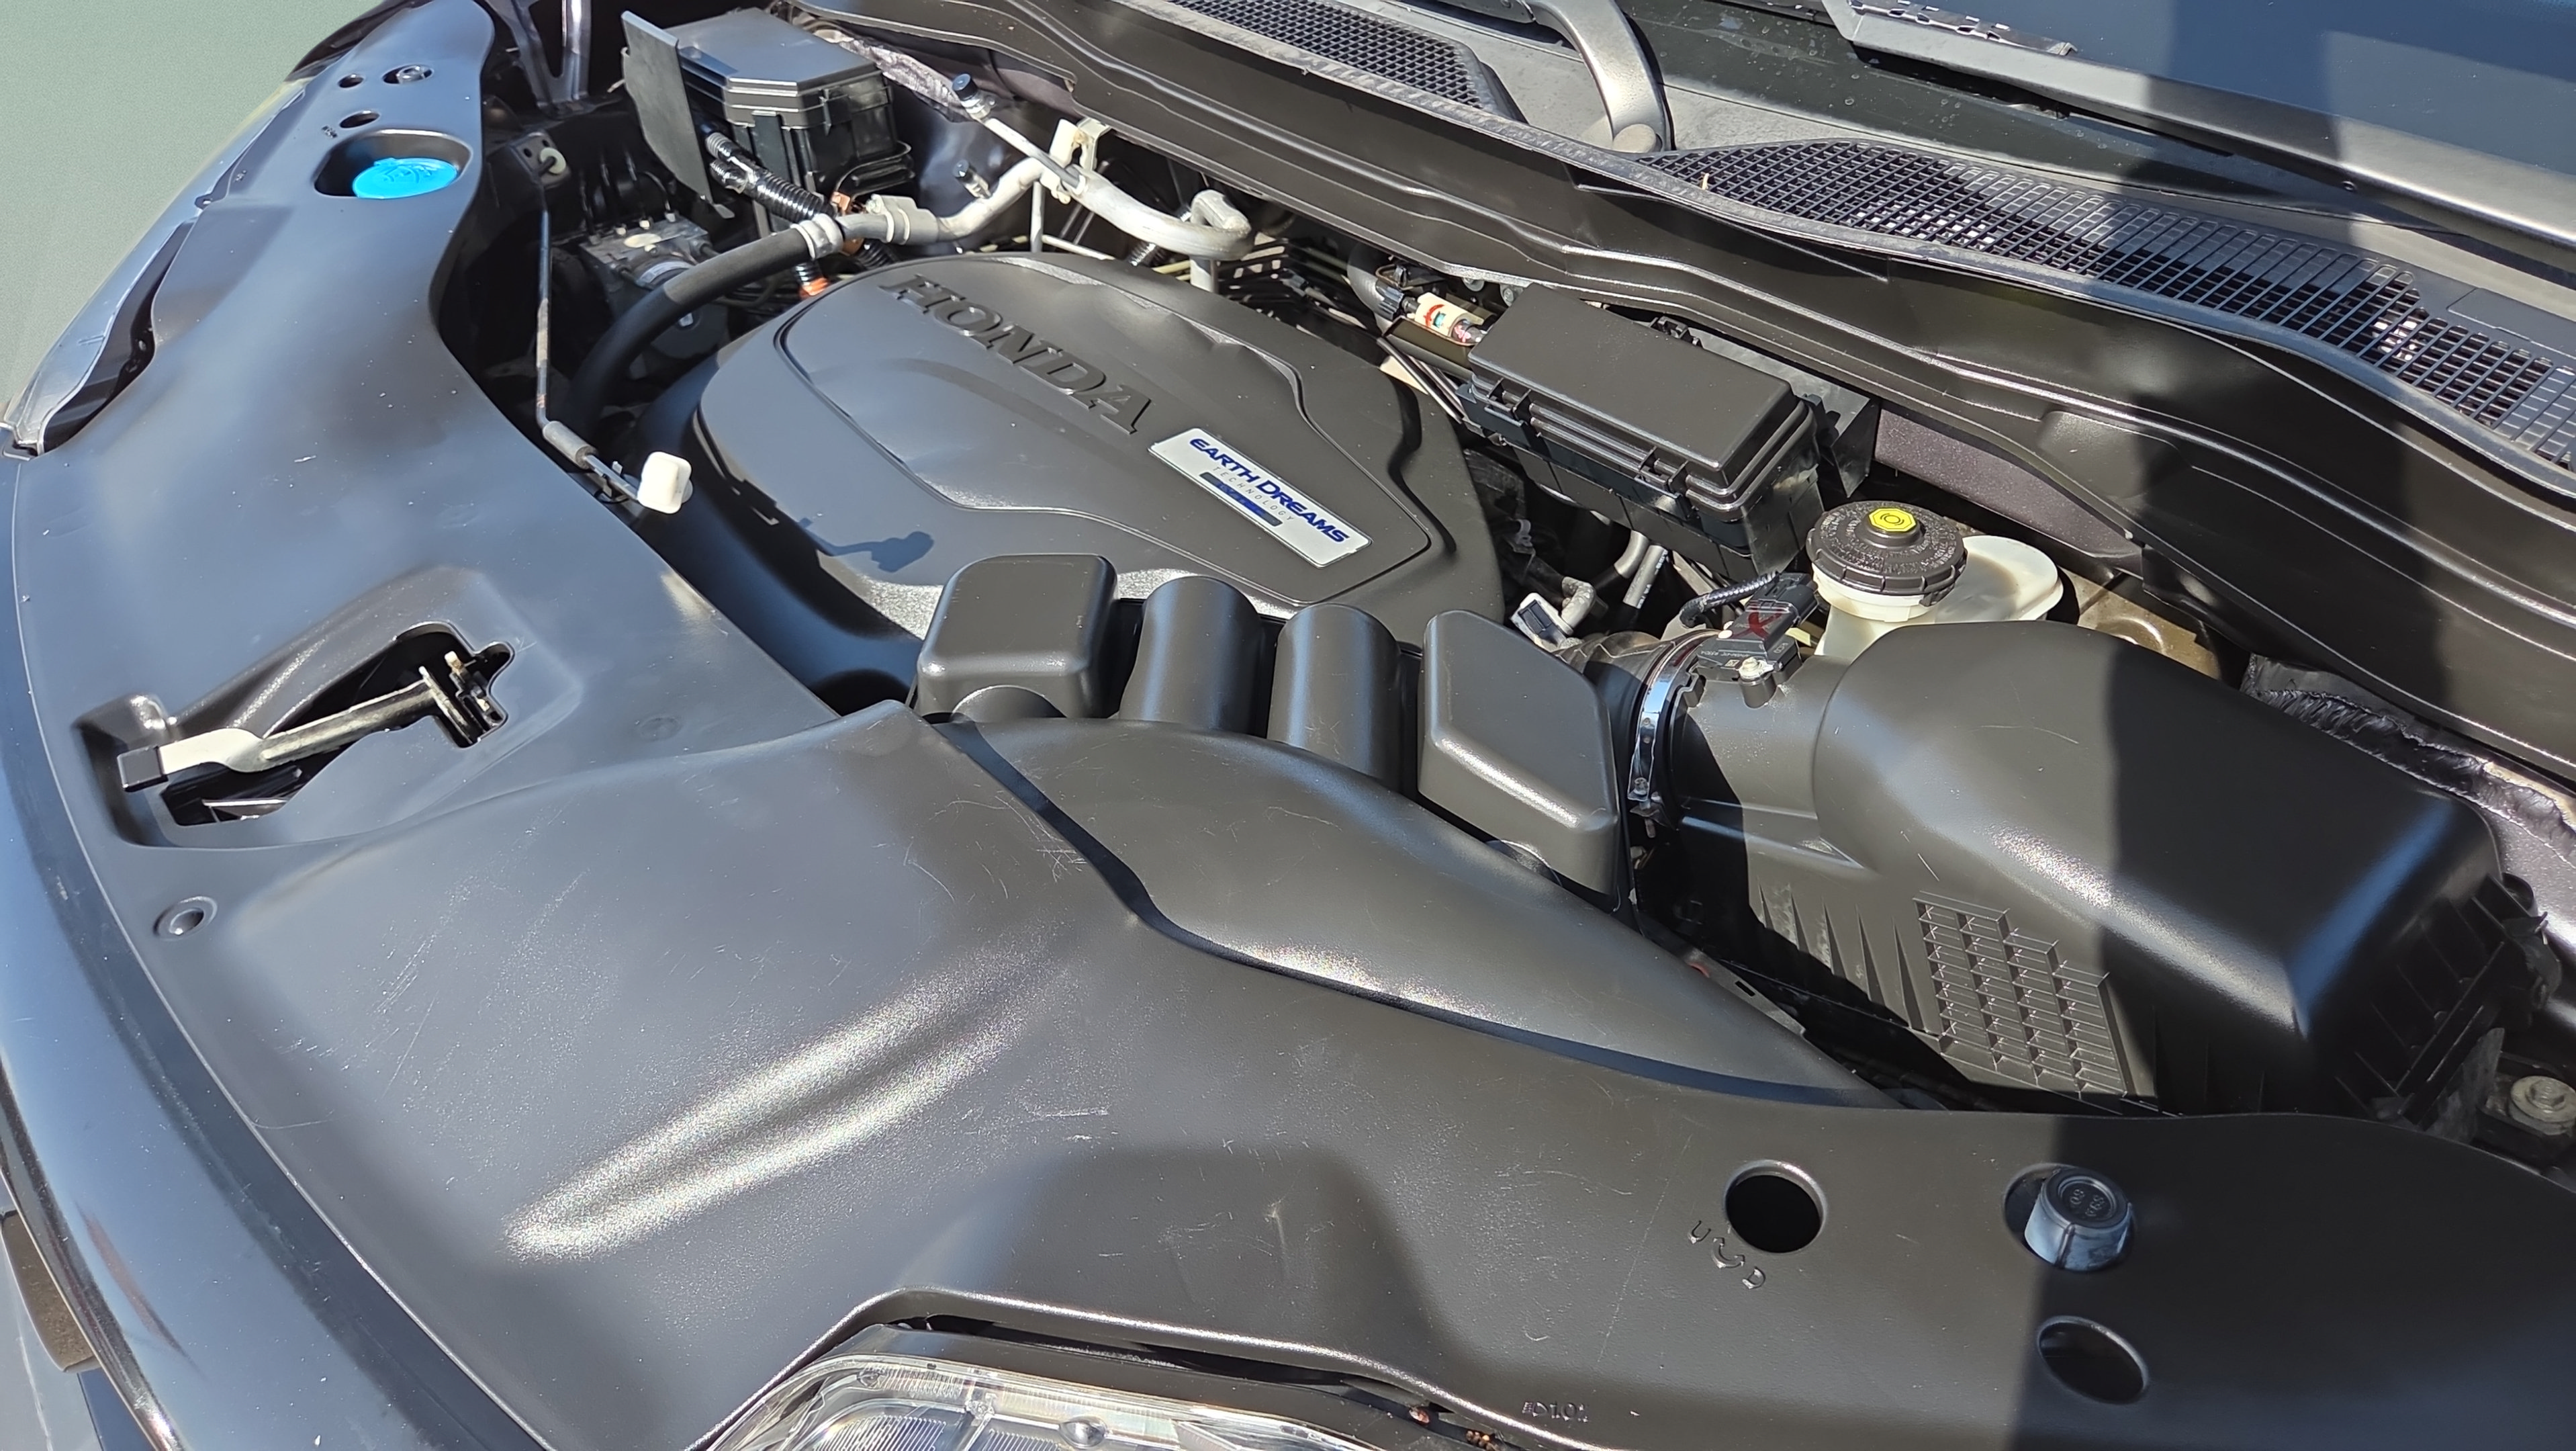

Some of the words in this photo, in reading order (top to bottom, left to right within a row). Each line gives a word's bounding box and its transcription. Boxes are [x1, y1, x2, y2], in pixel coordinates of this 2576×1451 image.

[878, 273, 1151, 435] HONDA
[1190, 439, 1260, 483] EARTH
[1212, 466, 1295, 521] TECHNOLOGY
